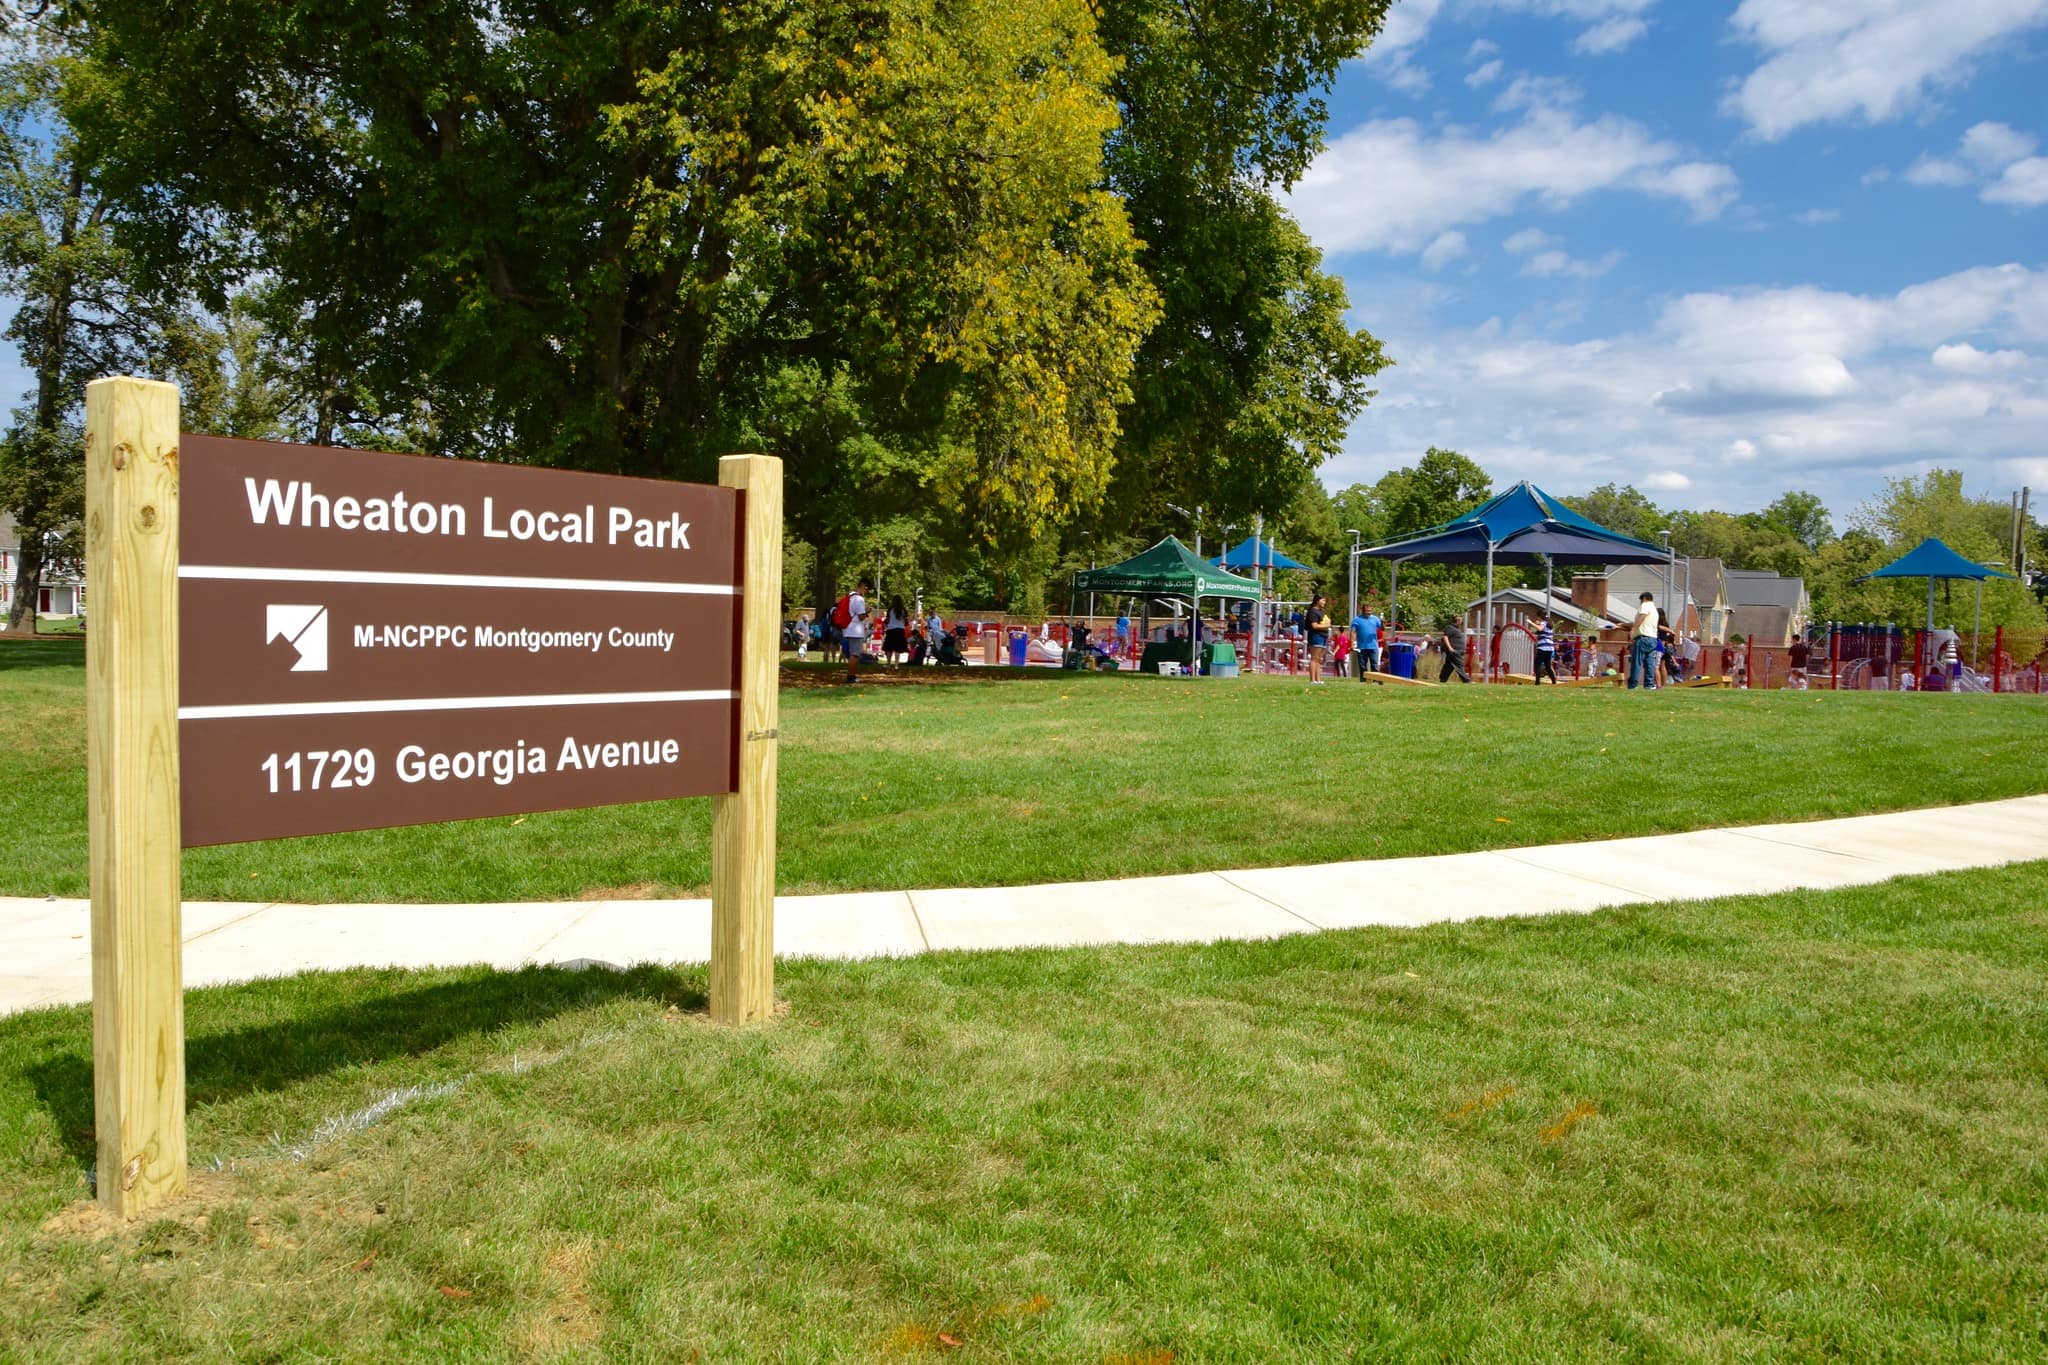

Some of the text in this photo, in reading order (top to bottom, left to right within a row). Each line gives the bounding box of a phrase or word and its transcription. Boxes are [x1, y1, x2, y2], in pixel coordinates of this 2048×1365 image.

[245, 477, 691, 550] Wheaton Local Park
[354, 625, 675, 653] M-NCPPC Montgomery County
[261, 736, 680, 793] 11729 Georgia Avenue
